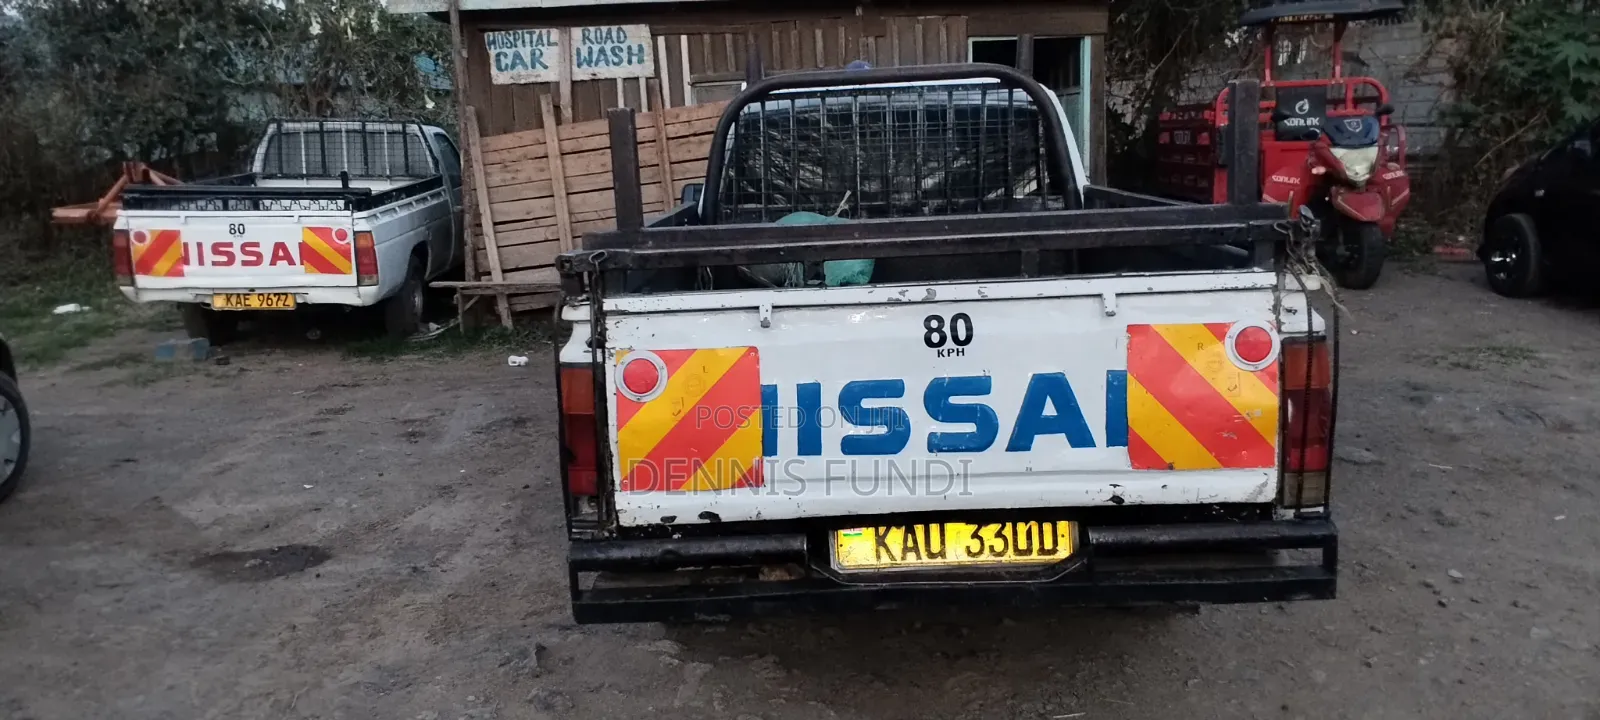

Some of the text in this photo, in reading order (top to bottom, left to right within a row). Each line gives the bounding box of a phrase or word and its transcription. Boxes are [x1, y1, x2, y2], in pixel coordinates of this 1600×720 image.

[487, 26, 628, 50] HOSPITAL ROAD
[495, 43, 645, 72] CAR WASH
[228, 223, 246, 235] 80
[225, 294, 252, 307] KAE
[923, 312, 974, 349] 80
[937, 347, 965, 358] KPH
[761, 369, 1128, 457] ISSA
[874, 523, 947, 562] KAU
